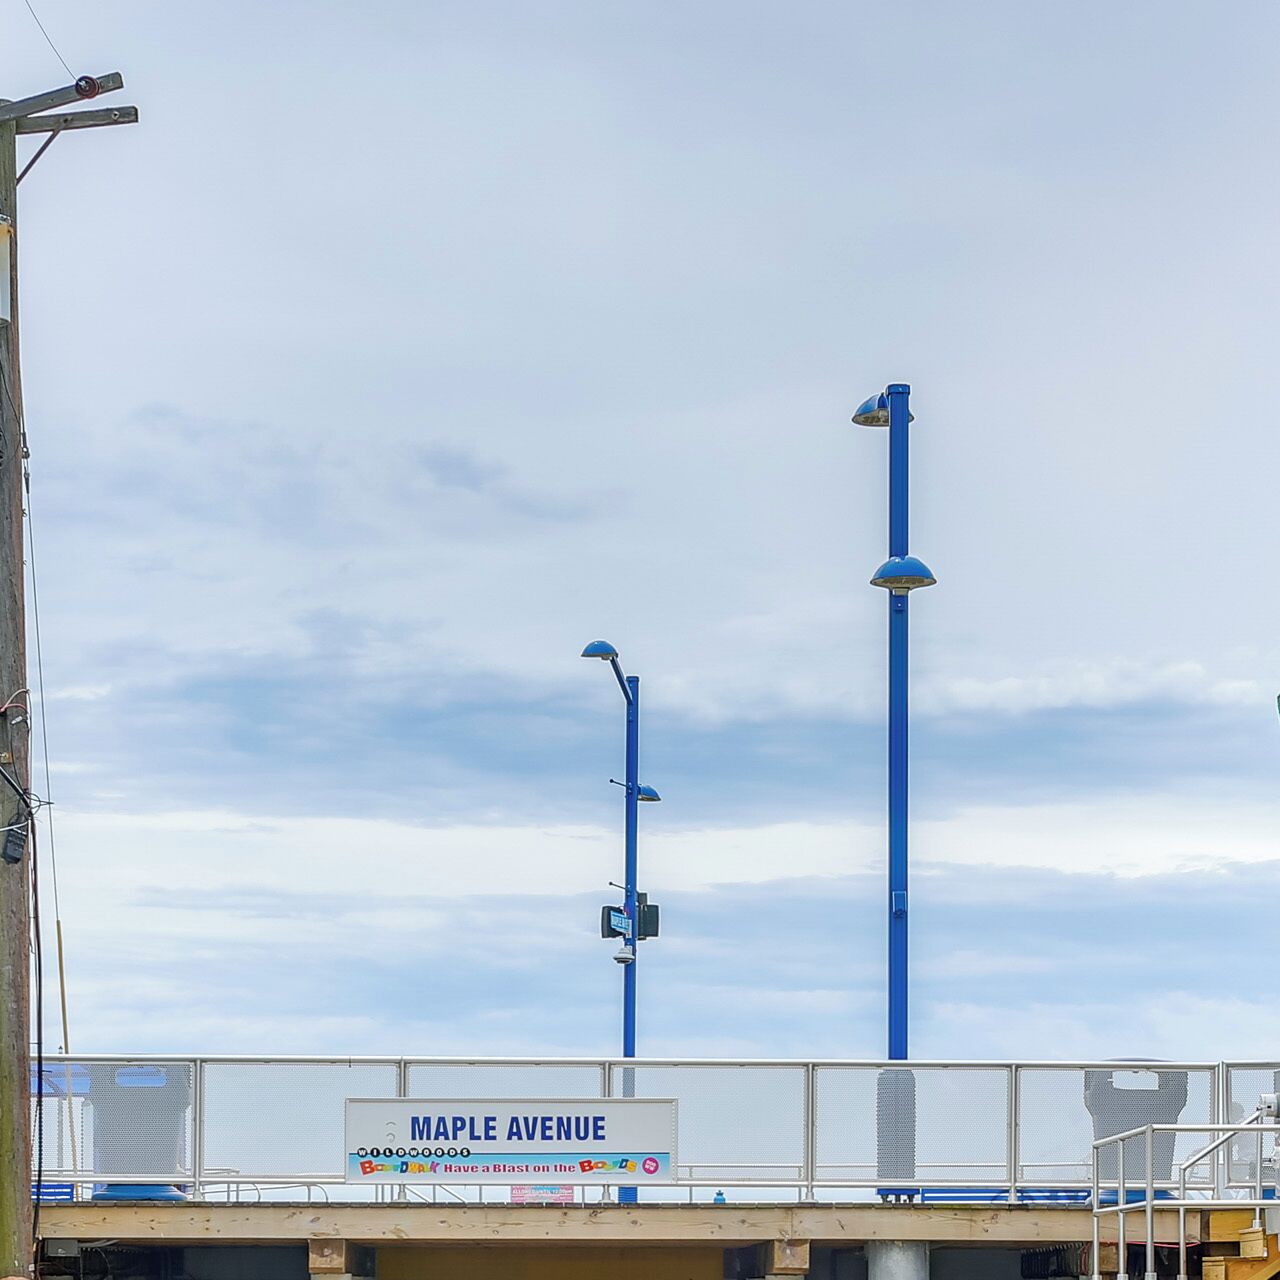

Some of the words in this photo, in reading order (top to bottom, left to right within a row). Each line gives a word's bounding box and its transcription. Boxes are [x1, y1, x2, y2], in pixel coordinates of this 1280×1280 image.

[410, 1116, 497, 1141] MAPLE
[506, 1116, 606, 1141] AVENUE
[357, 1147, 470, 1158] WILDWOODS
[444, 1164, 478, 1173] Have
[493, 1164, 529, 1173] Blast
[554, 1164, 576, 1173] the
